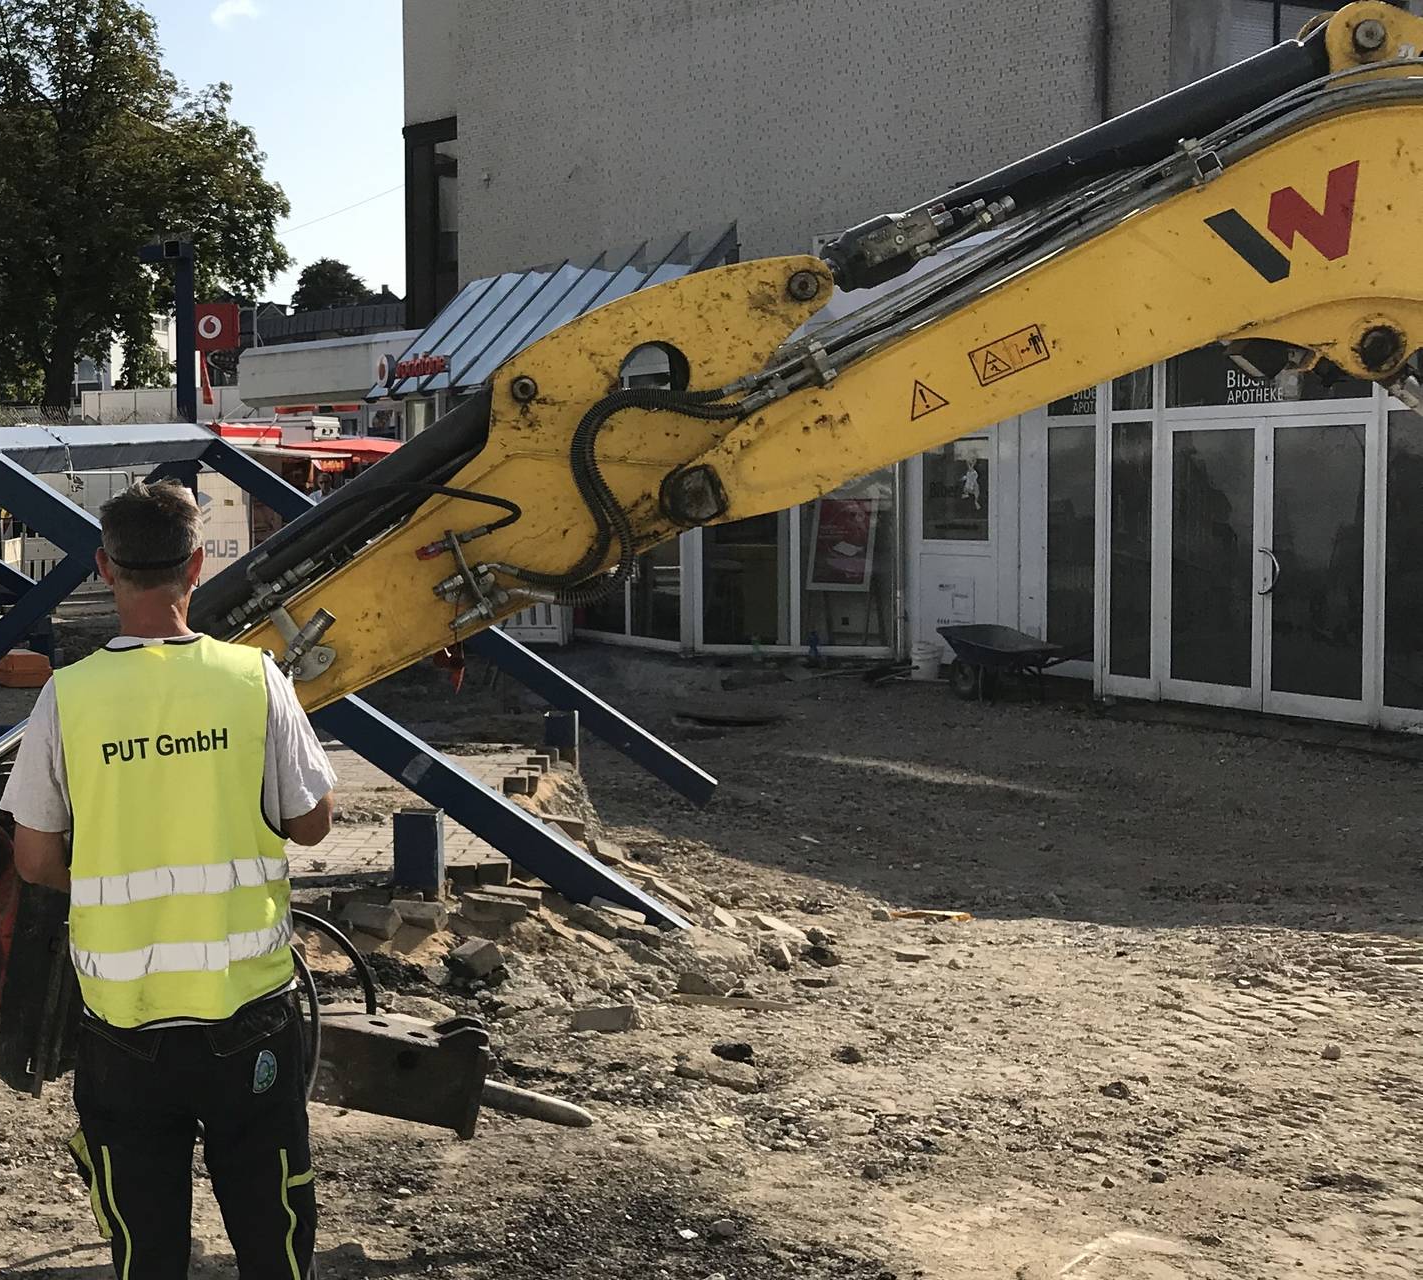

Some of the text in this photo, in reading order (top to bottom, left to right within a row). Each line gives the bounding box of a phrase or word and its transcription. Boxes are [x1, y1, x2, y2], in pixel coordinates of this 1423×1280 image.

[1226, 387, 1284, 405] APOTHEKE
[101, 728, 228, 764] PUT GmbH
